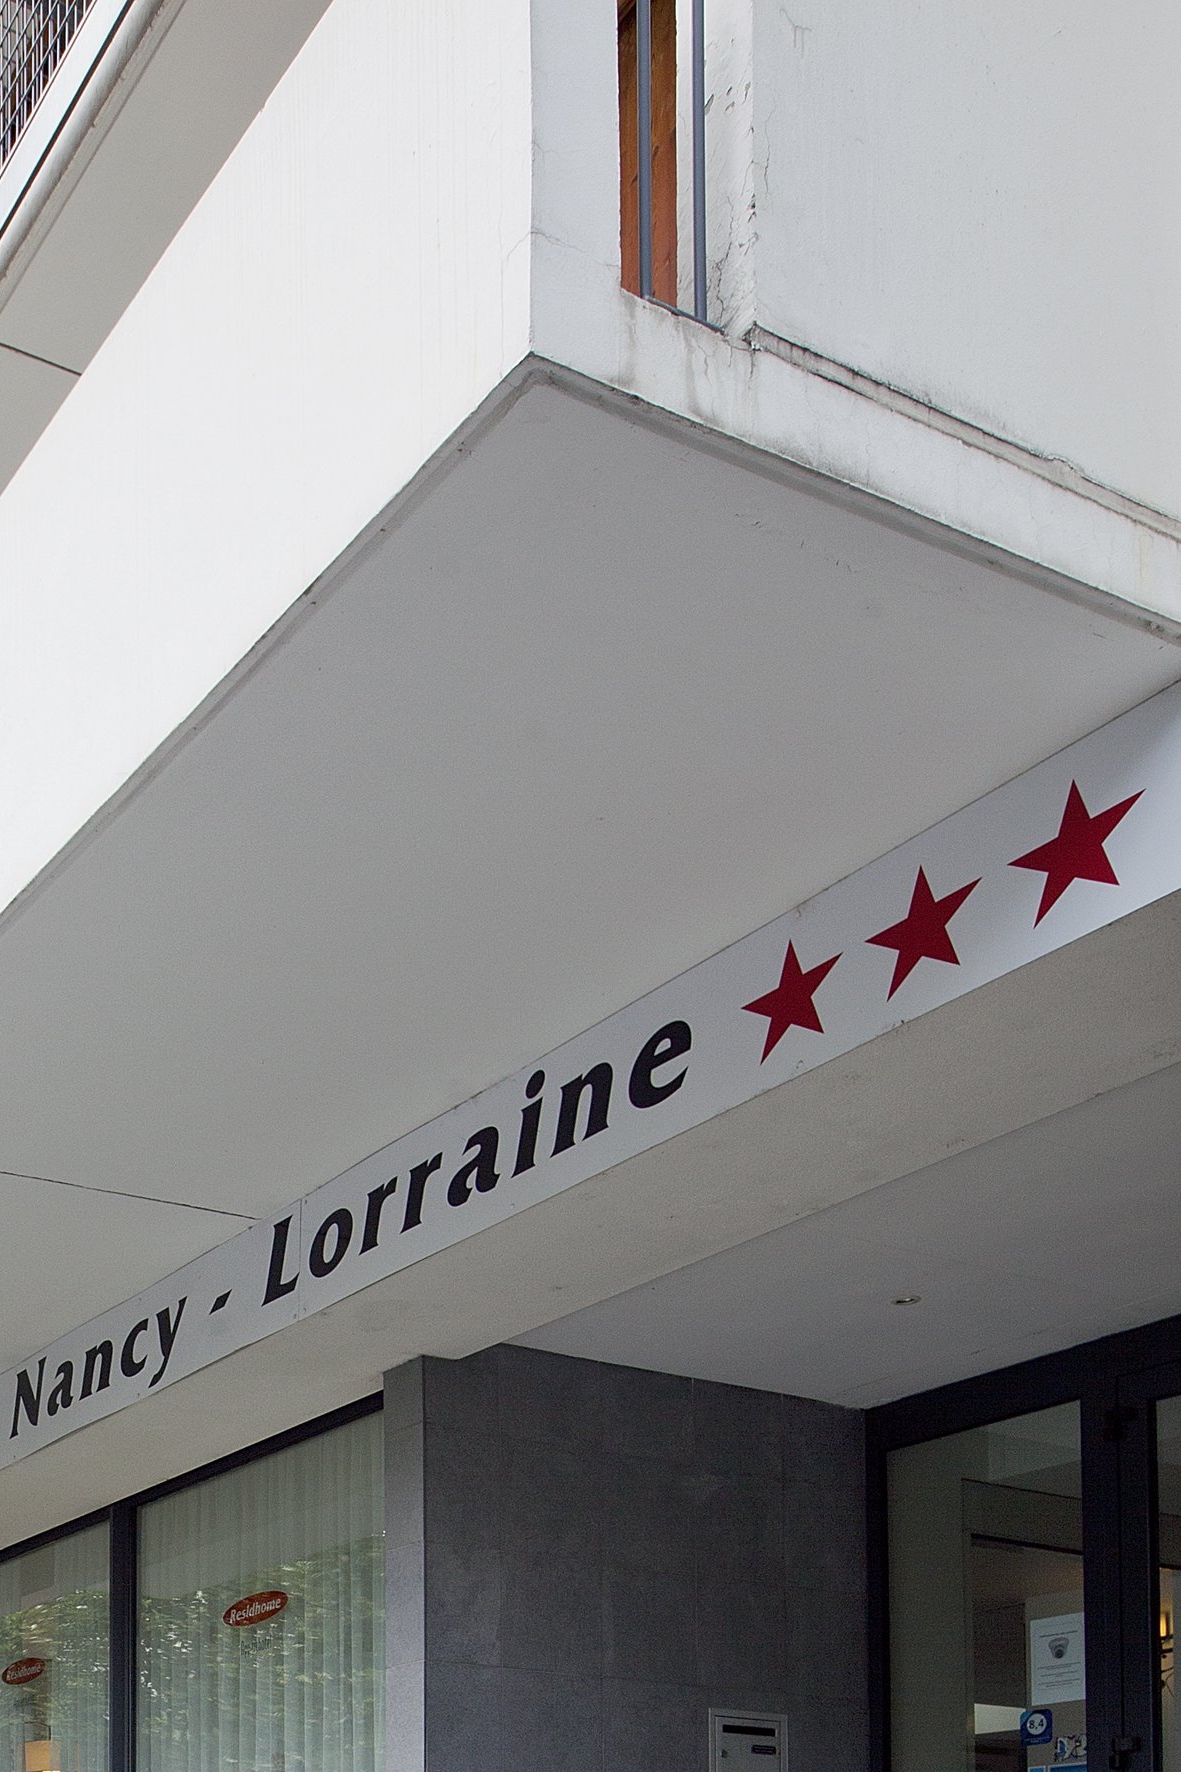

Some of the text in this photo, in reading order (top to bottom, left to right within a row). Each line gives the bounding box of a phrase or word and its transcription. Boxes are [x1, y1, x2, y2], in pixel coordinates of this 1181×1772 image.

[9, 1296, 188, 1440] Nancy
[209, 1289, 233, 1315] -
[261, 1019, 693, 1307] Lorraine
[229, 1599, 282, 1624] Residhome
[1028, 1718, 1045, 1730] 8,4
